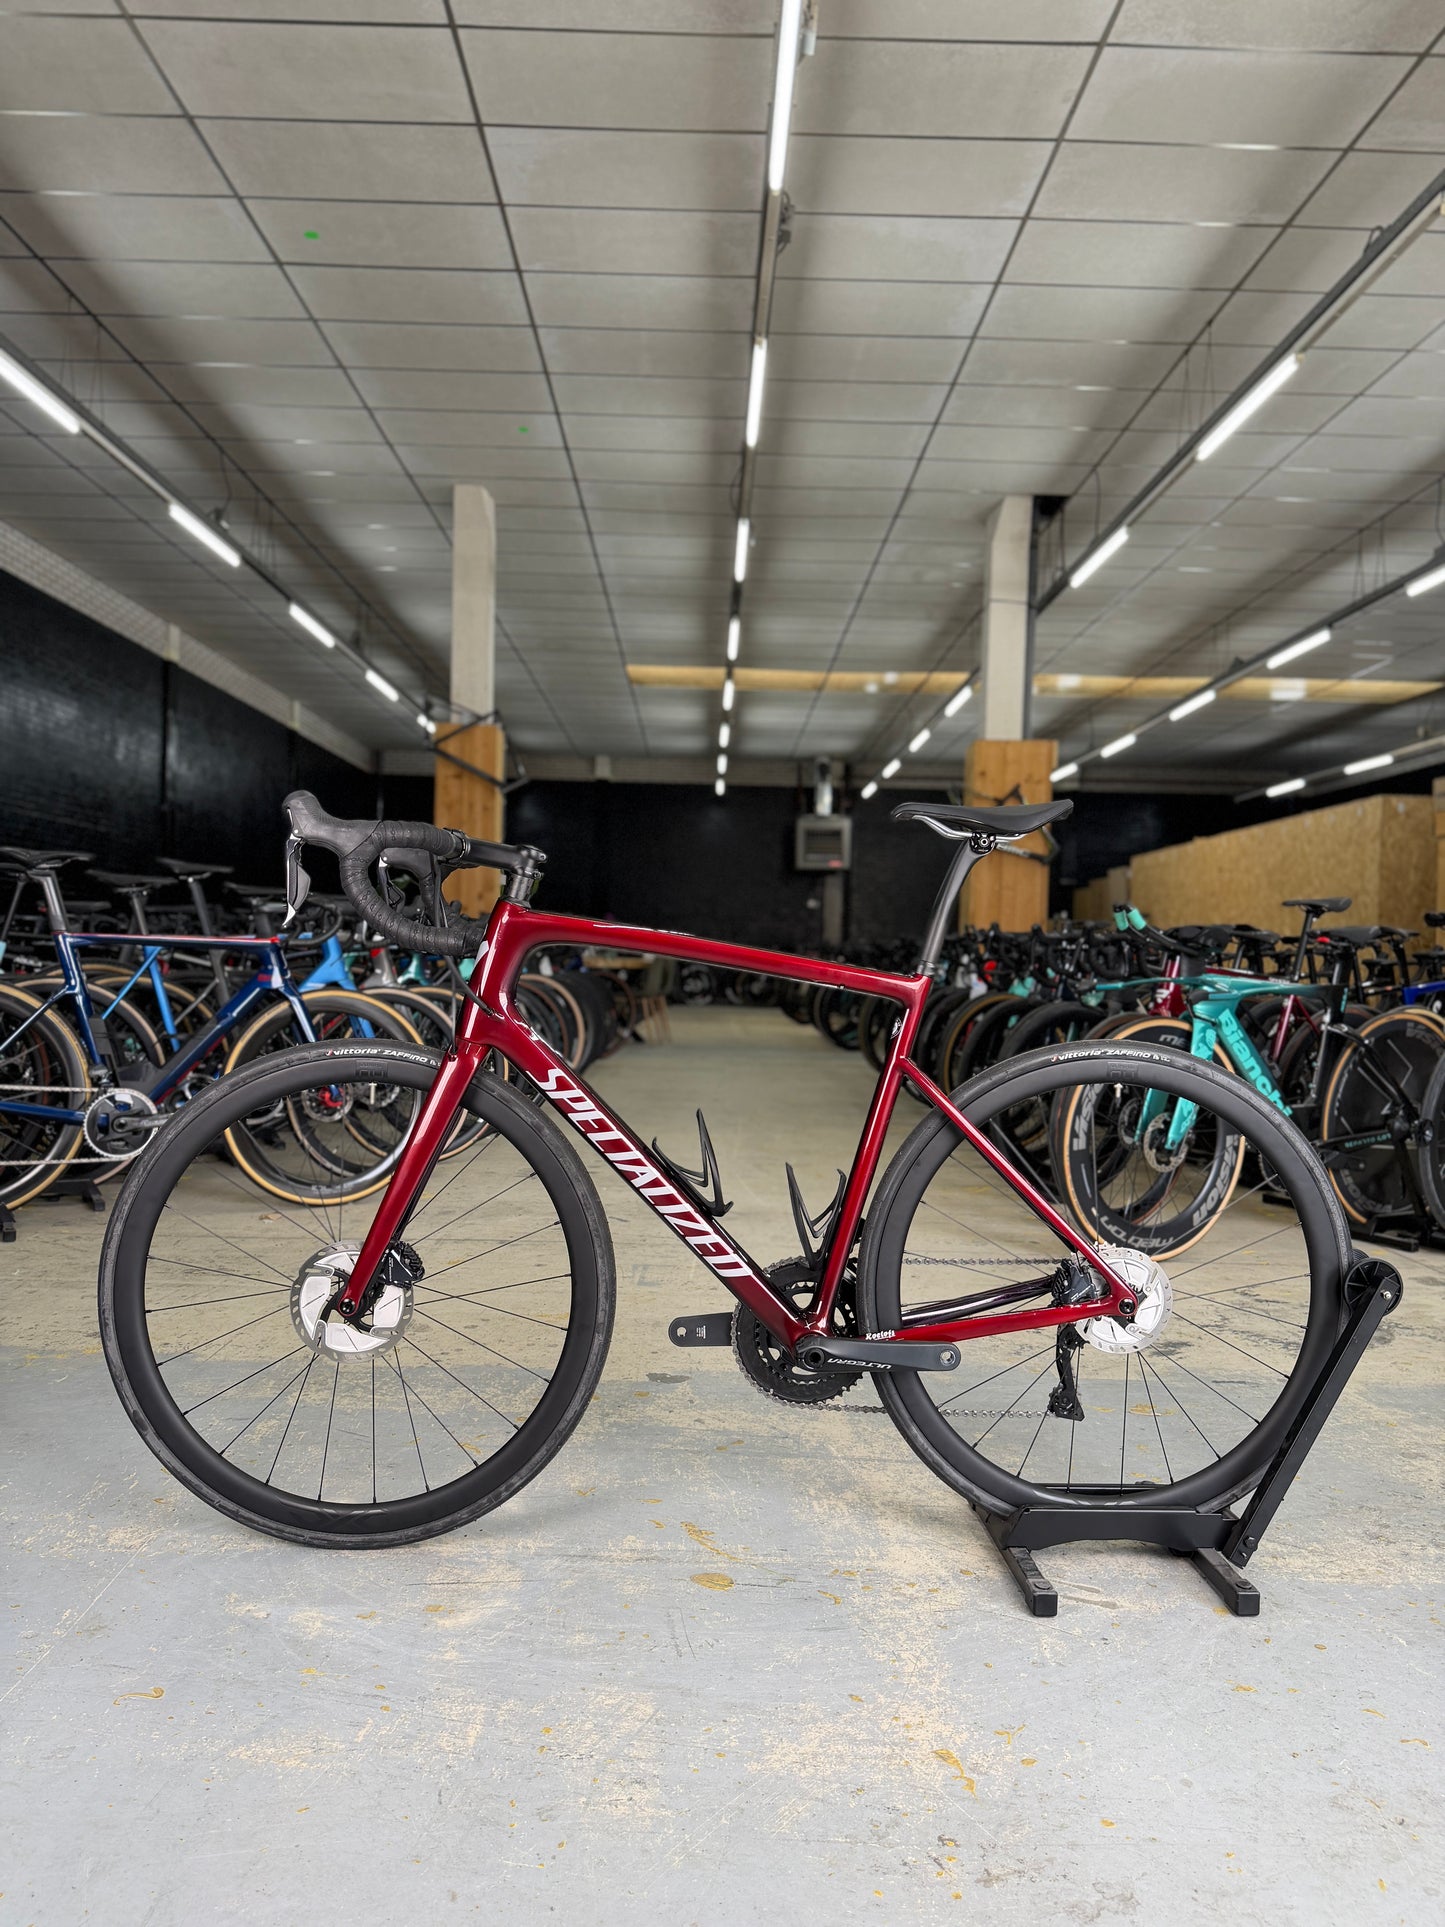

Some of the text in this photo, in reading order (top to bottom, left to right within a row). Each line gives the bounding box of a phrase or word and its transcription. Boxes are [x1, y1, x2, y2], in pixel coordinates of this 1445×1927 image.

[333, 1048, 378, 1056] vittoria
[1058, 1050, 1101, 1061] vittoria
[1218, 1008, 1293, 1117] Bianchi
[526, 1068, 753, 1278] SPECIALIZED
[865, 1329, 896, 1341] Roelofs
[827, 1358, 892, 1369] ULTEGRA
